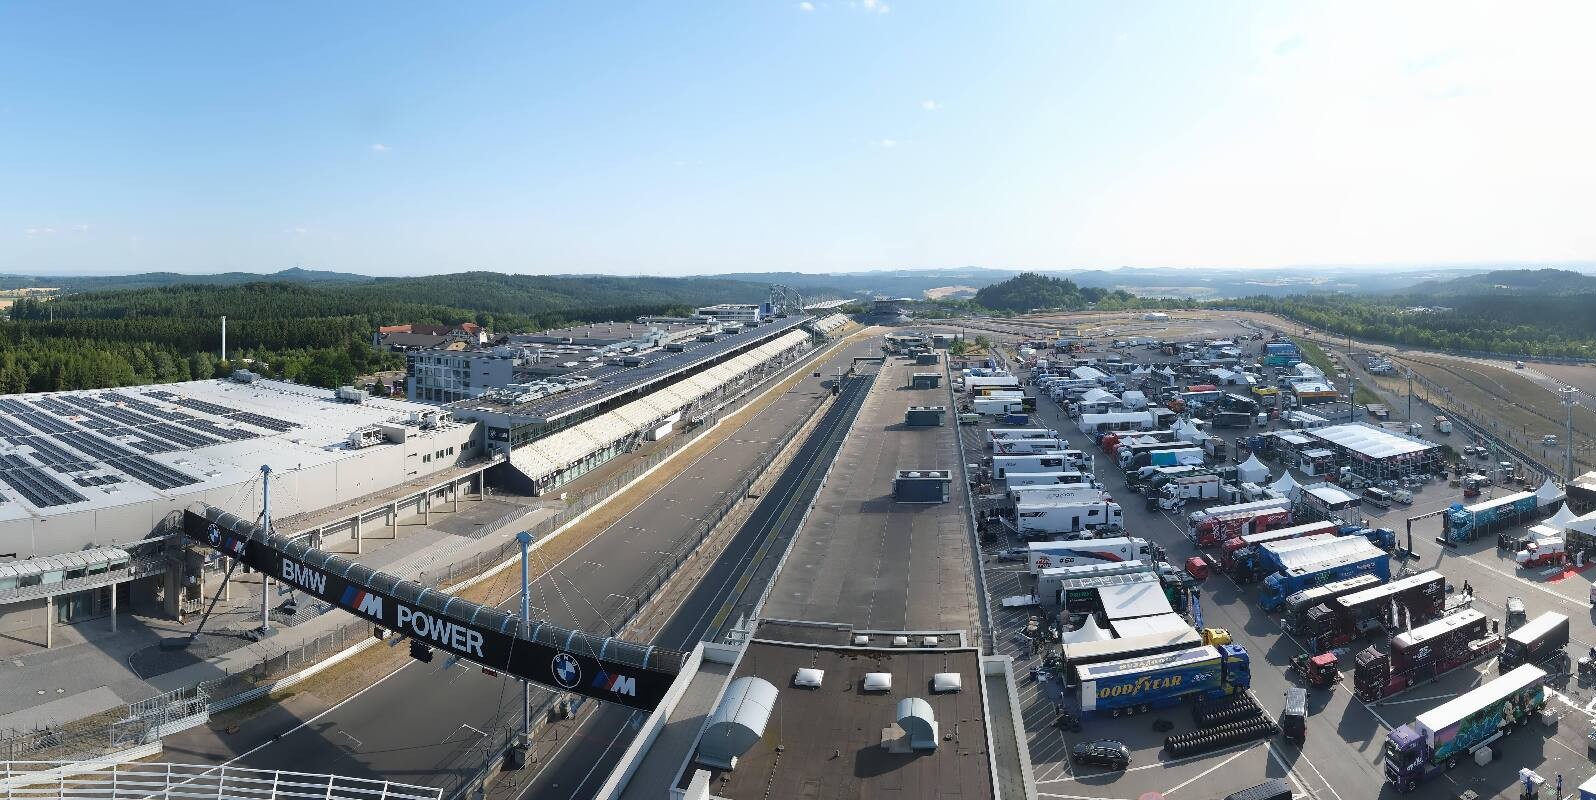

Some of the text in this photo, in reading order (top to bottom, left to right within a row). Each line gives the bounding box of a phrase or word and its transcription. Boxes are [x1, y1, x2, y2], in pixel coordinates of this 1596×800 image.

[282, 557, 327, 596] BMW
[397, 604, 484, 658] POWER
[1096, 676, 1182, 698] OODYEAR
